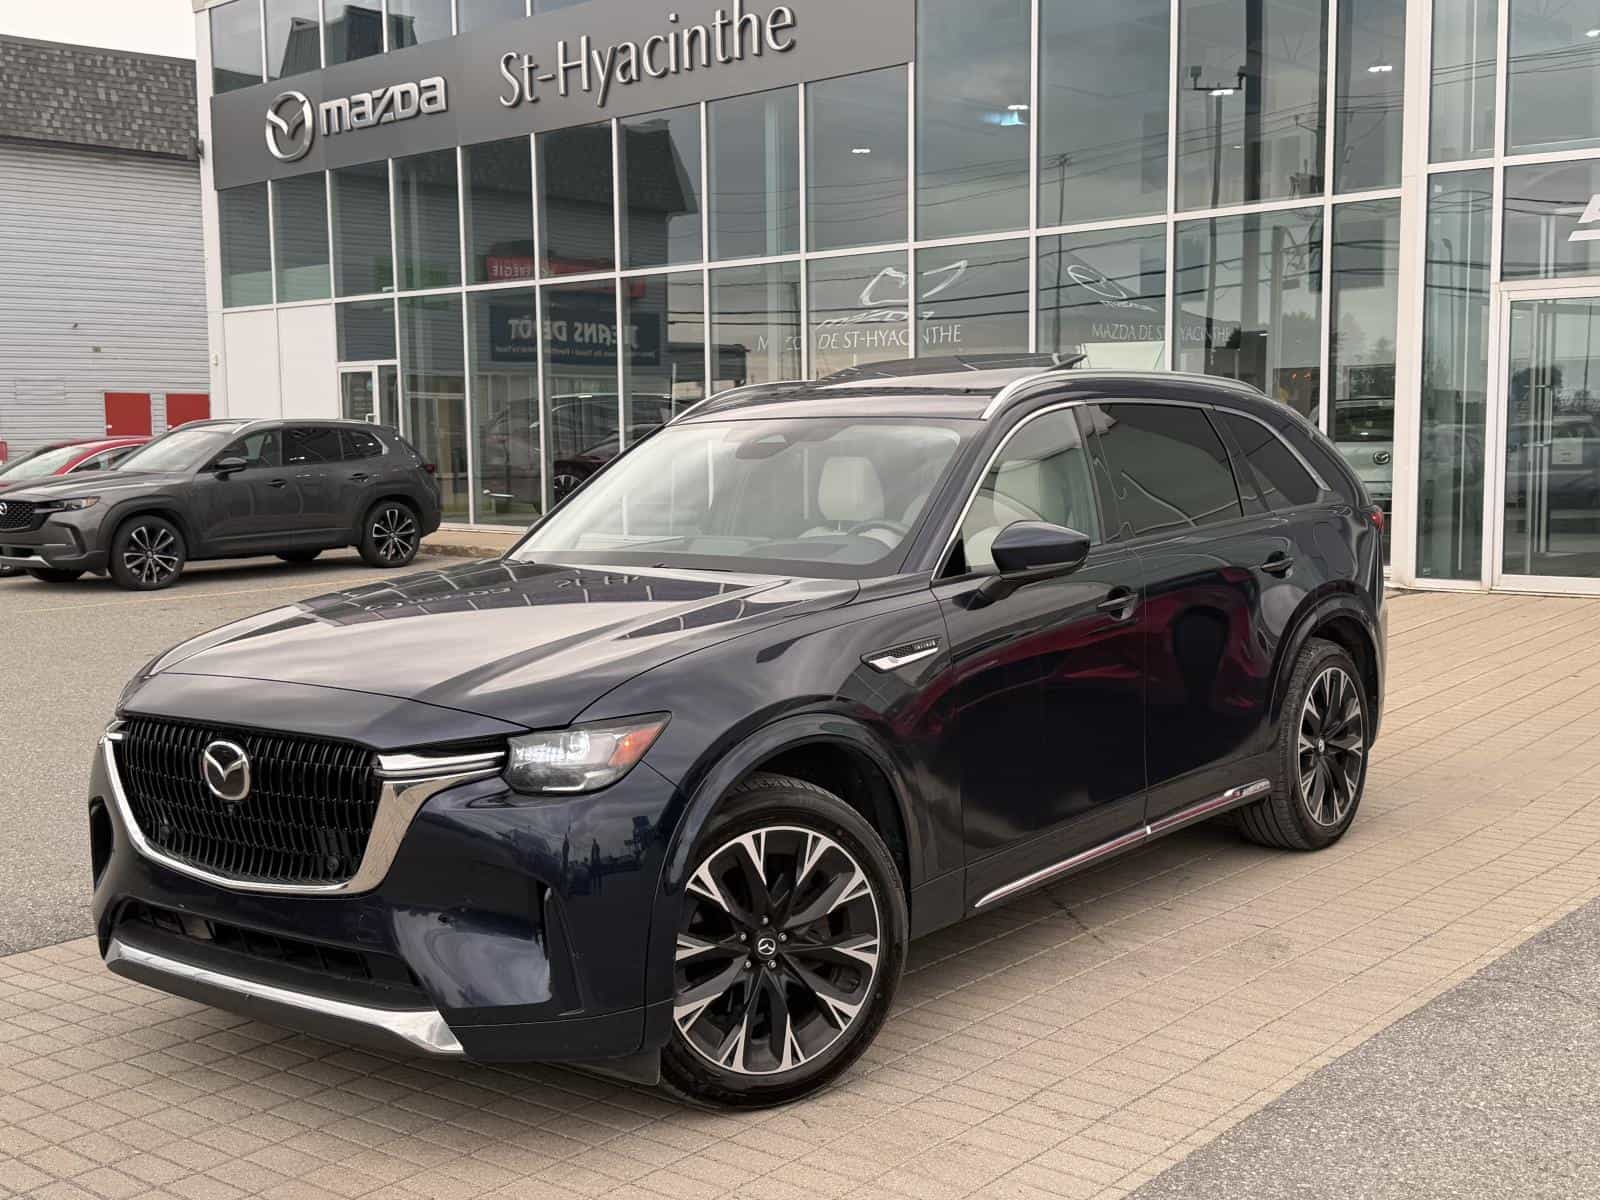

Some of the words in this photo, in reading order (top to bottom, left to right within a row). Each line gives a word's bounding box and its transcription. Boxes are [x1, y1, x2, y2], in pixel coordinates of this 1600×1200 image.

[499, 0, 796, 108] St-Hyacinthe
[319, 76, 447, 136] mazda
[818, 332, 838, 350] DE
[843, 325, 961, 349] ST-HYACNTHE
